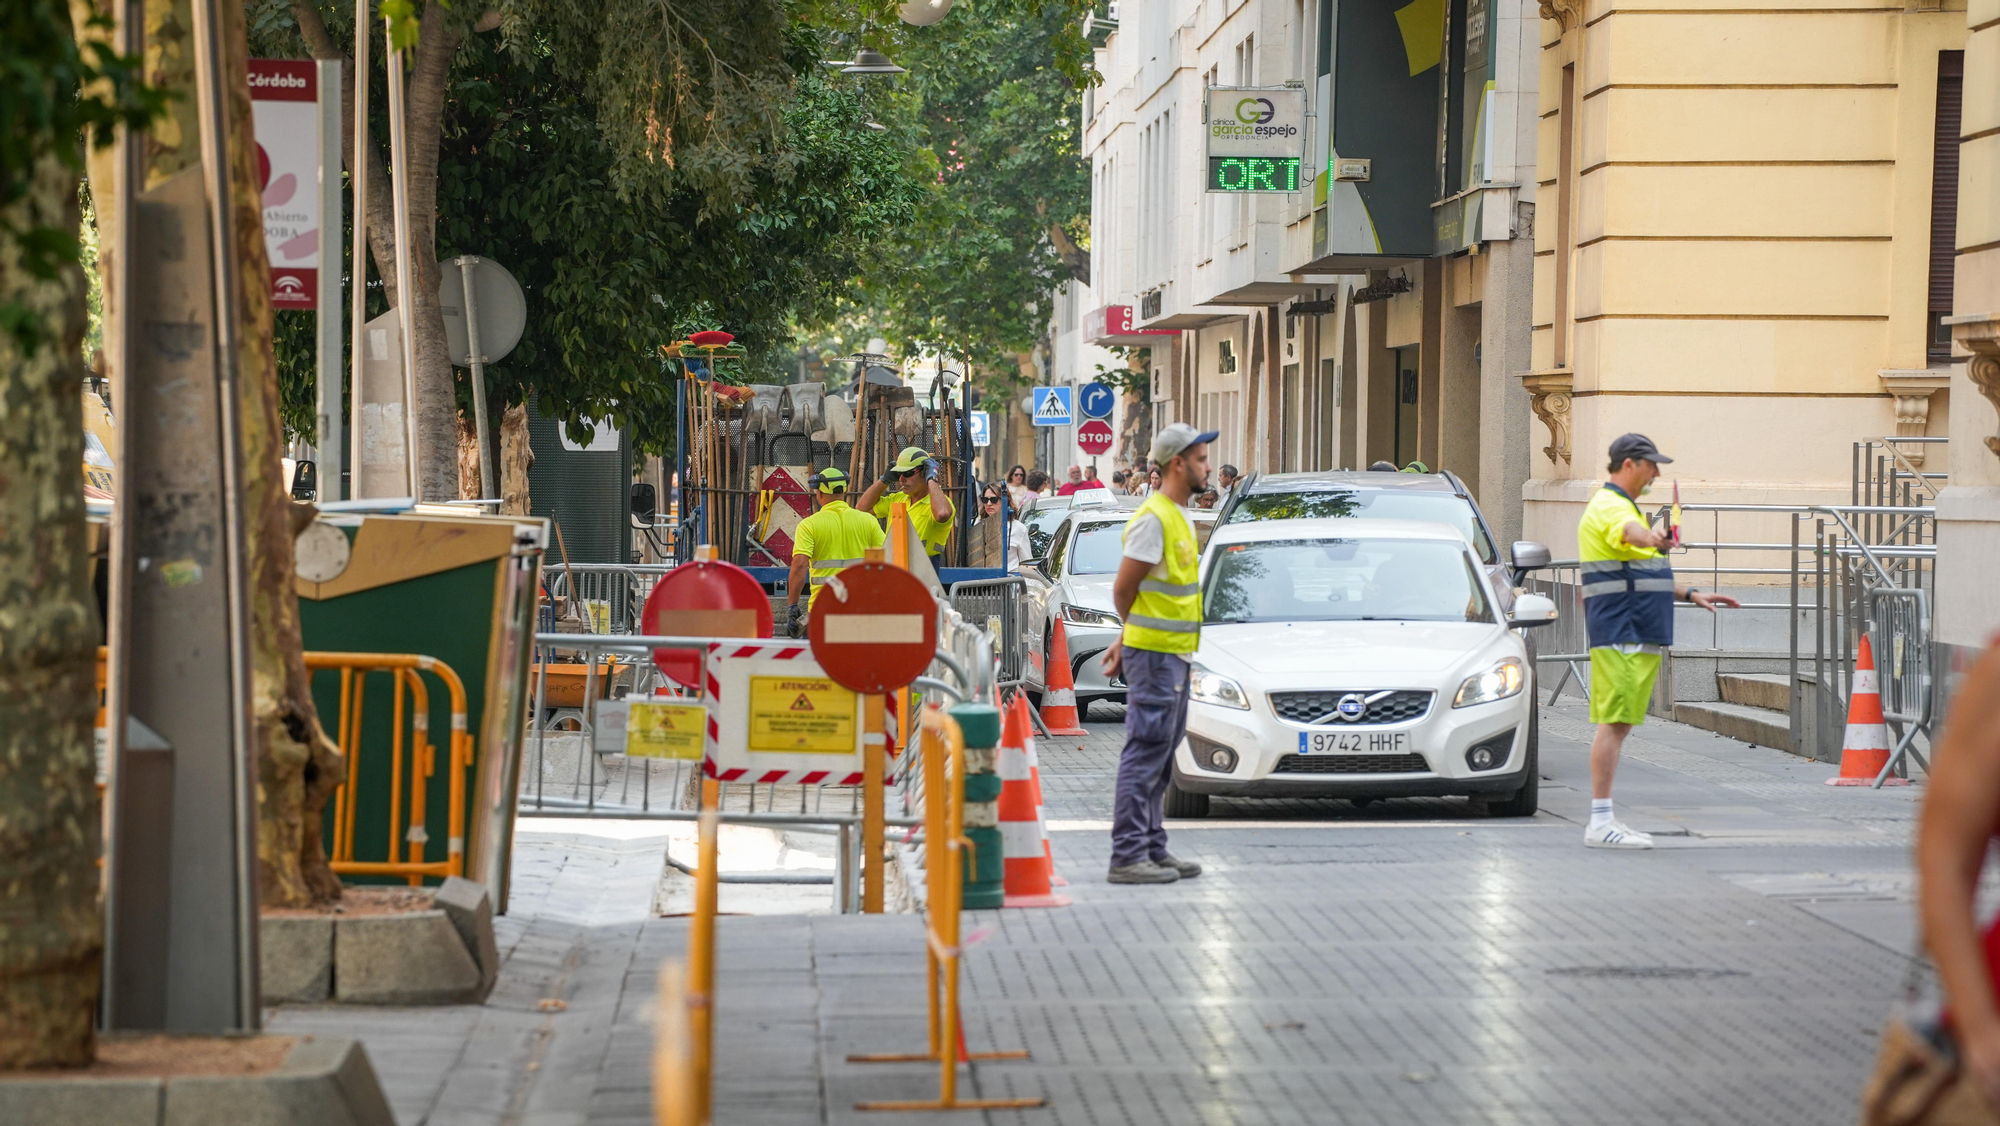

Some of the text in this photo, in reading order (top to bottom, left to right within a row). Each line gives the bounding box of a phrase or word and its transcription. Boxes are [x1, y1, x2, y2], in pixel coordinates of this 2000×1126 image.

[246, 72, 306, 88] Córdoba
[1254, 124, 1297, 138] espejo
[1219, 159, 1299, 190] ORT
[1079, 433, 1112, 443] STOP
[1080, 491, 1102, 501] TAXI
[1313, 734, 1405, 751] 9742 HHF
